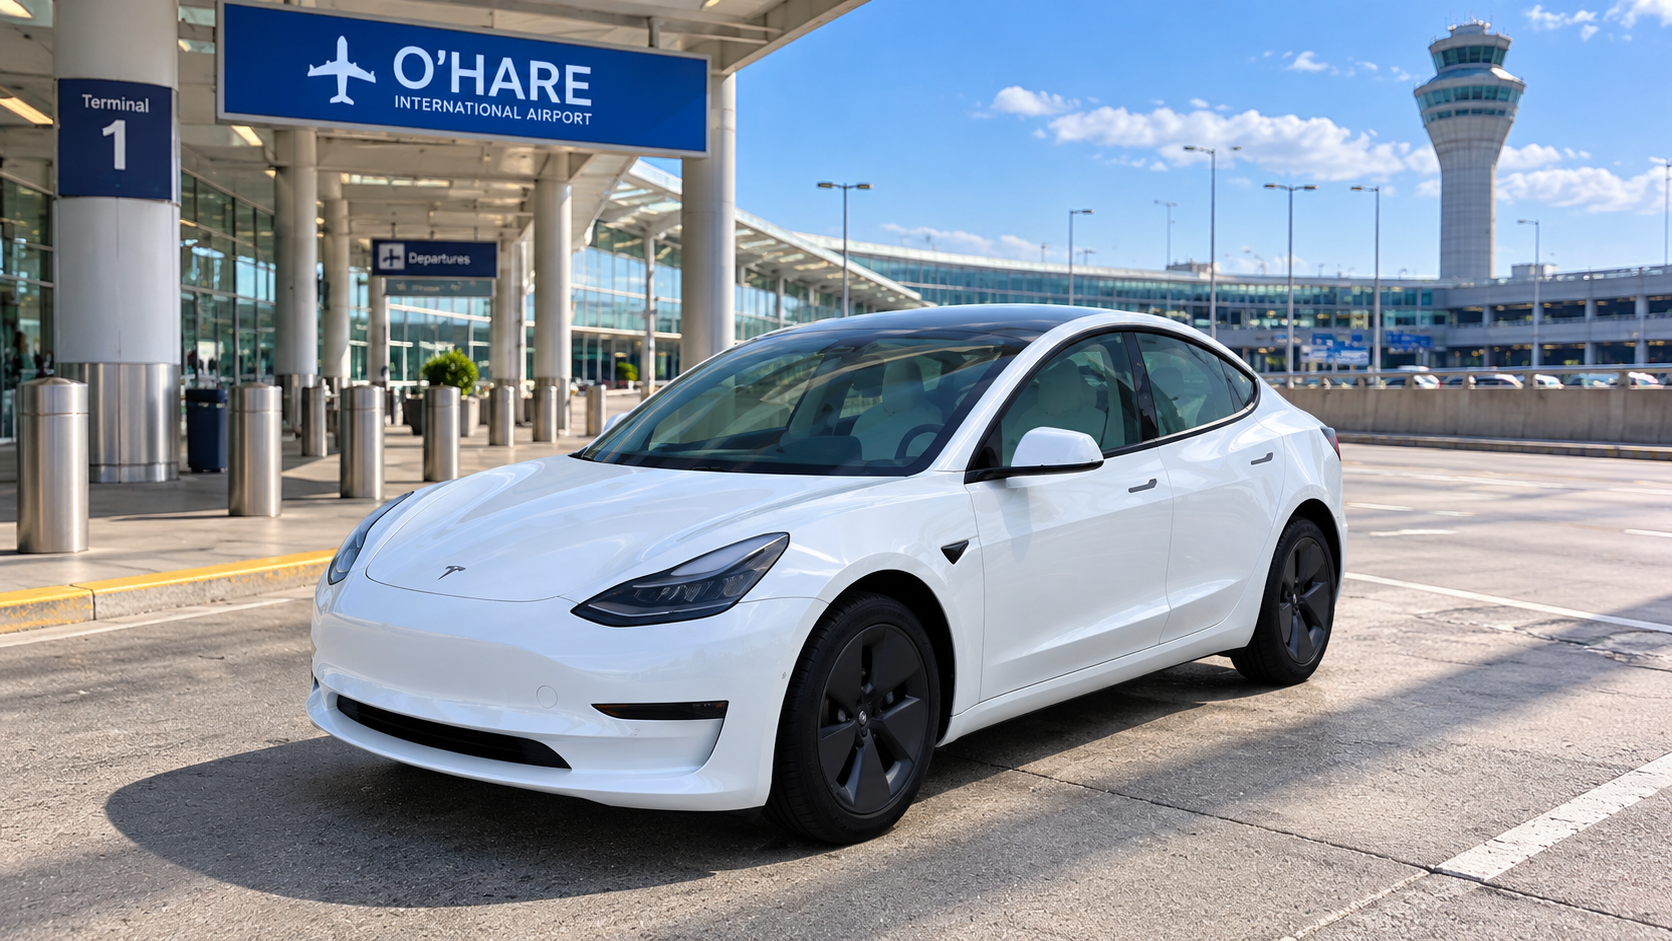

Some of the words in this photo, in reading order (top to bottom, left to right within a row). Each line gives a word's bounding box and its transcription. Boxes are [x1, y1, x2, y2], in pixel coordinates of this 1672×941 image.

[393, 45, 592, 107] O'HARE
[82, 94, 149, 113] Terminal
[395, 95, 521, 120] INTERNATIONAL
[526, 108, 592, 125] AIRPORT
[102, 119, 126, 170] 1
[408, 251, 471, 266] Departures
